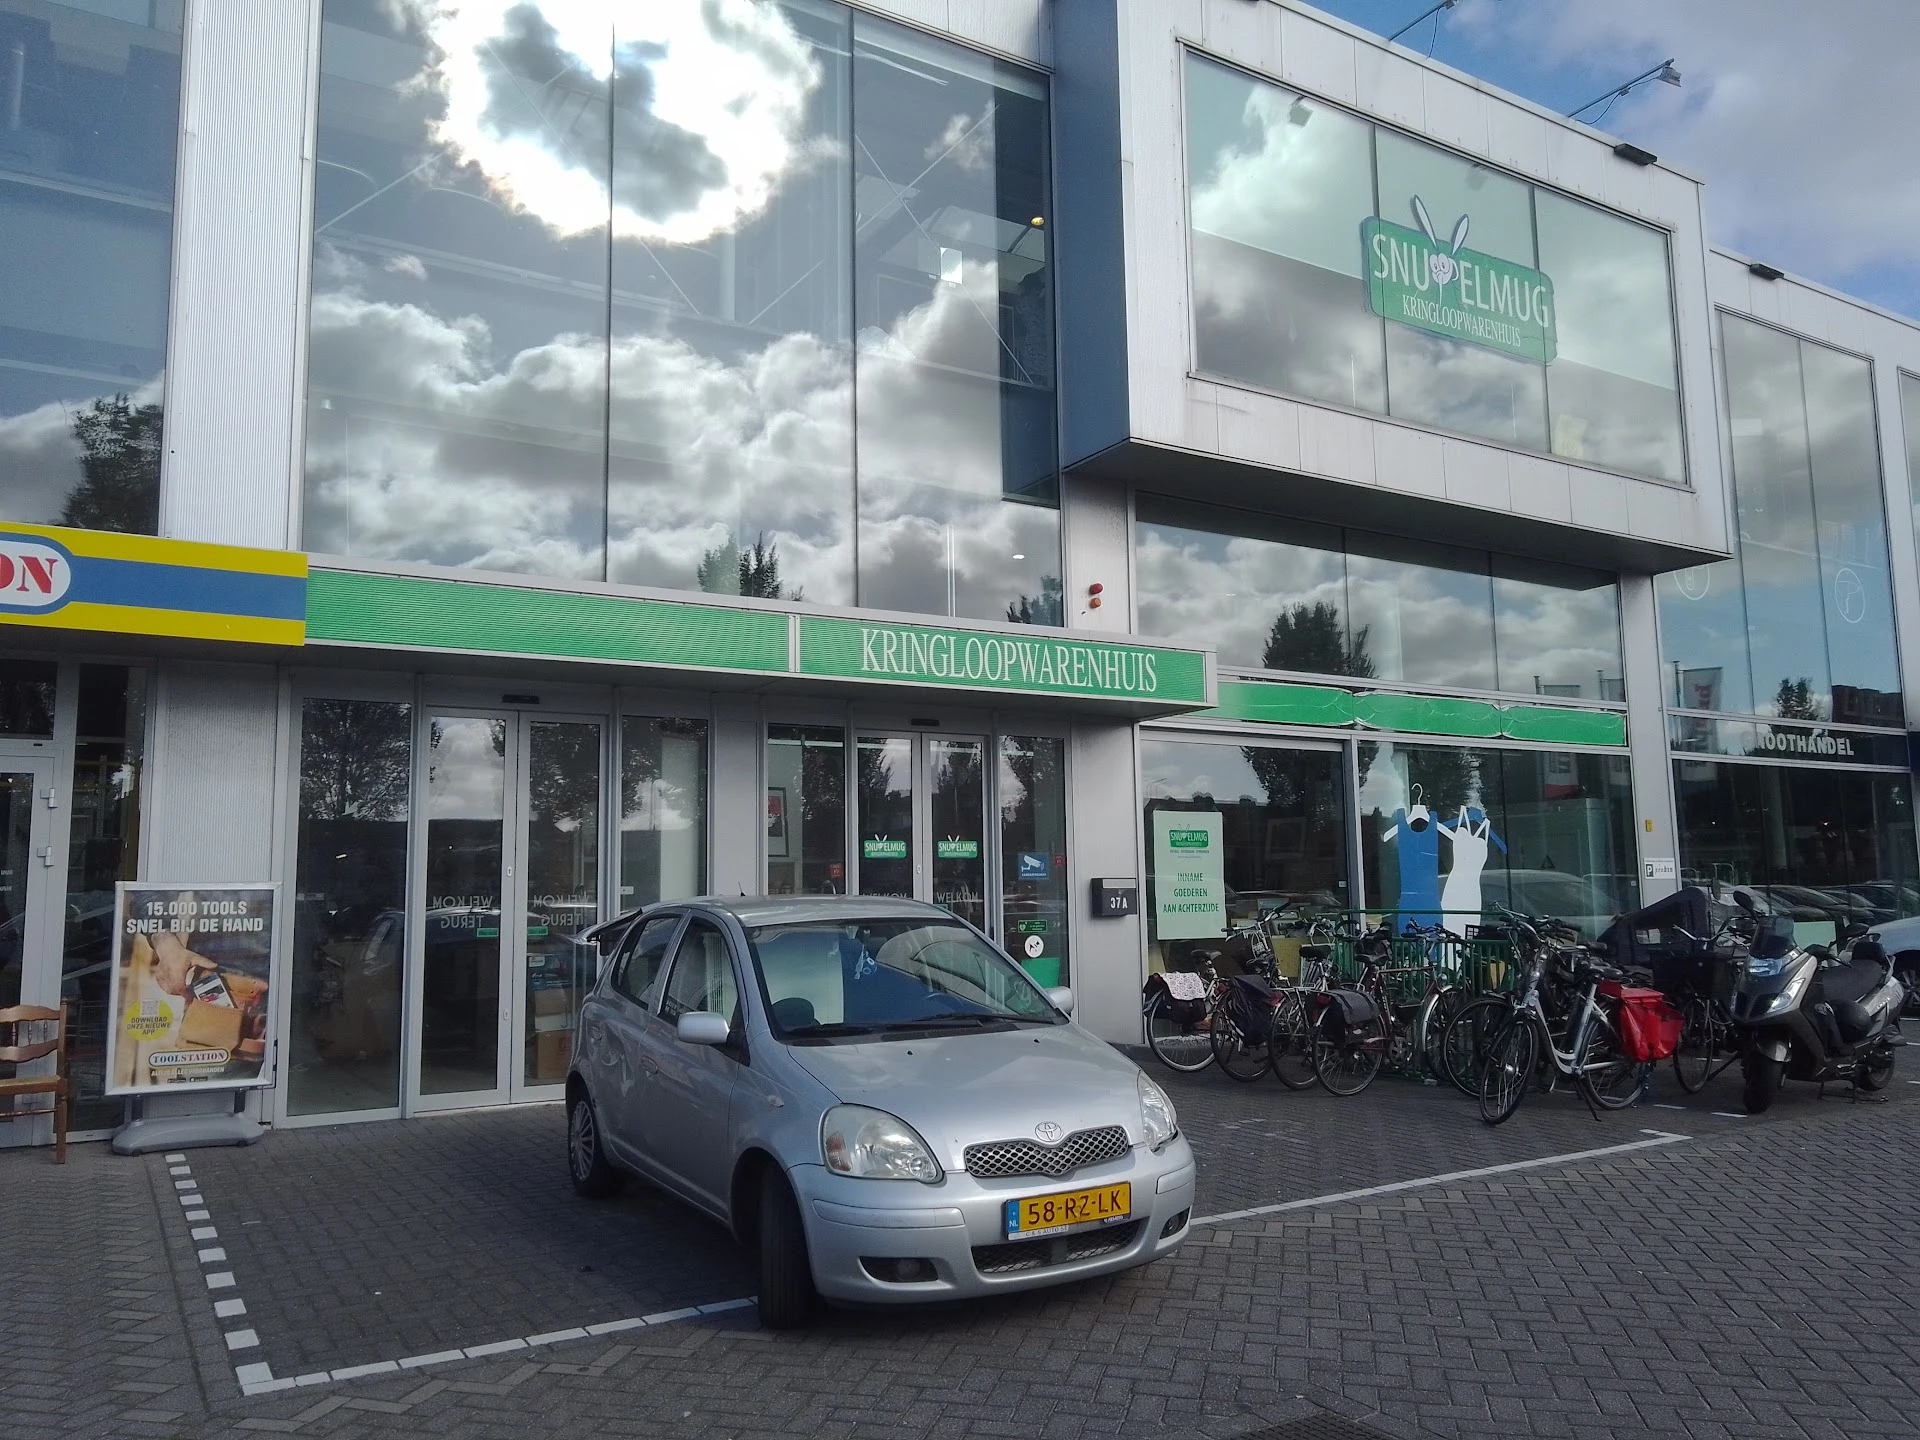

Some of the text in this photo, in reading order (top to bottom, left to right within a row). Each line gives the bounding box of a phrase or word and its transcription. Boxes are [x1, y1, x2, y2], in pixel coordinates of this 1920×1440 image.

[1402, 294, 1521, 347] KRINGLOOPWARENHUIS
[860, 628, 1157, 692] KRINGLOOPWARENHUIS
[1177, 872, 1204, 882] INNAME
[936, 891, 979, 903] WELKOM
[1173, 888, 1208, 897] GOEDEREN
[146, 900, 248, 916] 15.000 TOOLS
[1163, 904, 1176, 913] AAN
[126, 917, 264, 934] SNEL BIJ DE HAND
[130, 1016, 168, 1024] DOWNLOAD
[152, 1052, 227, 1064] TOOLSTATION
[1028, 1190, 1122, 1225] 58-RZ-LK
[1009, 1220, 1019, 1228] NL
